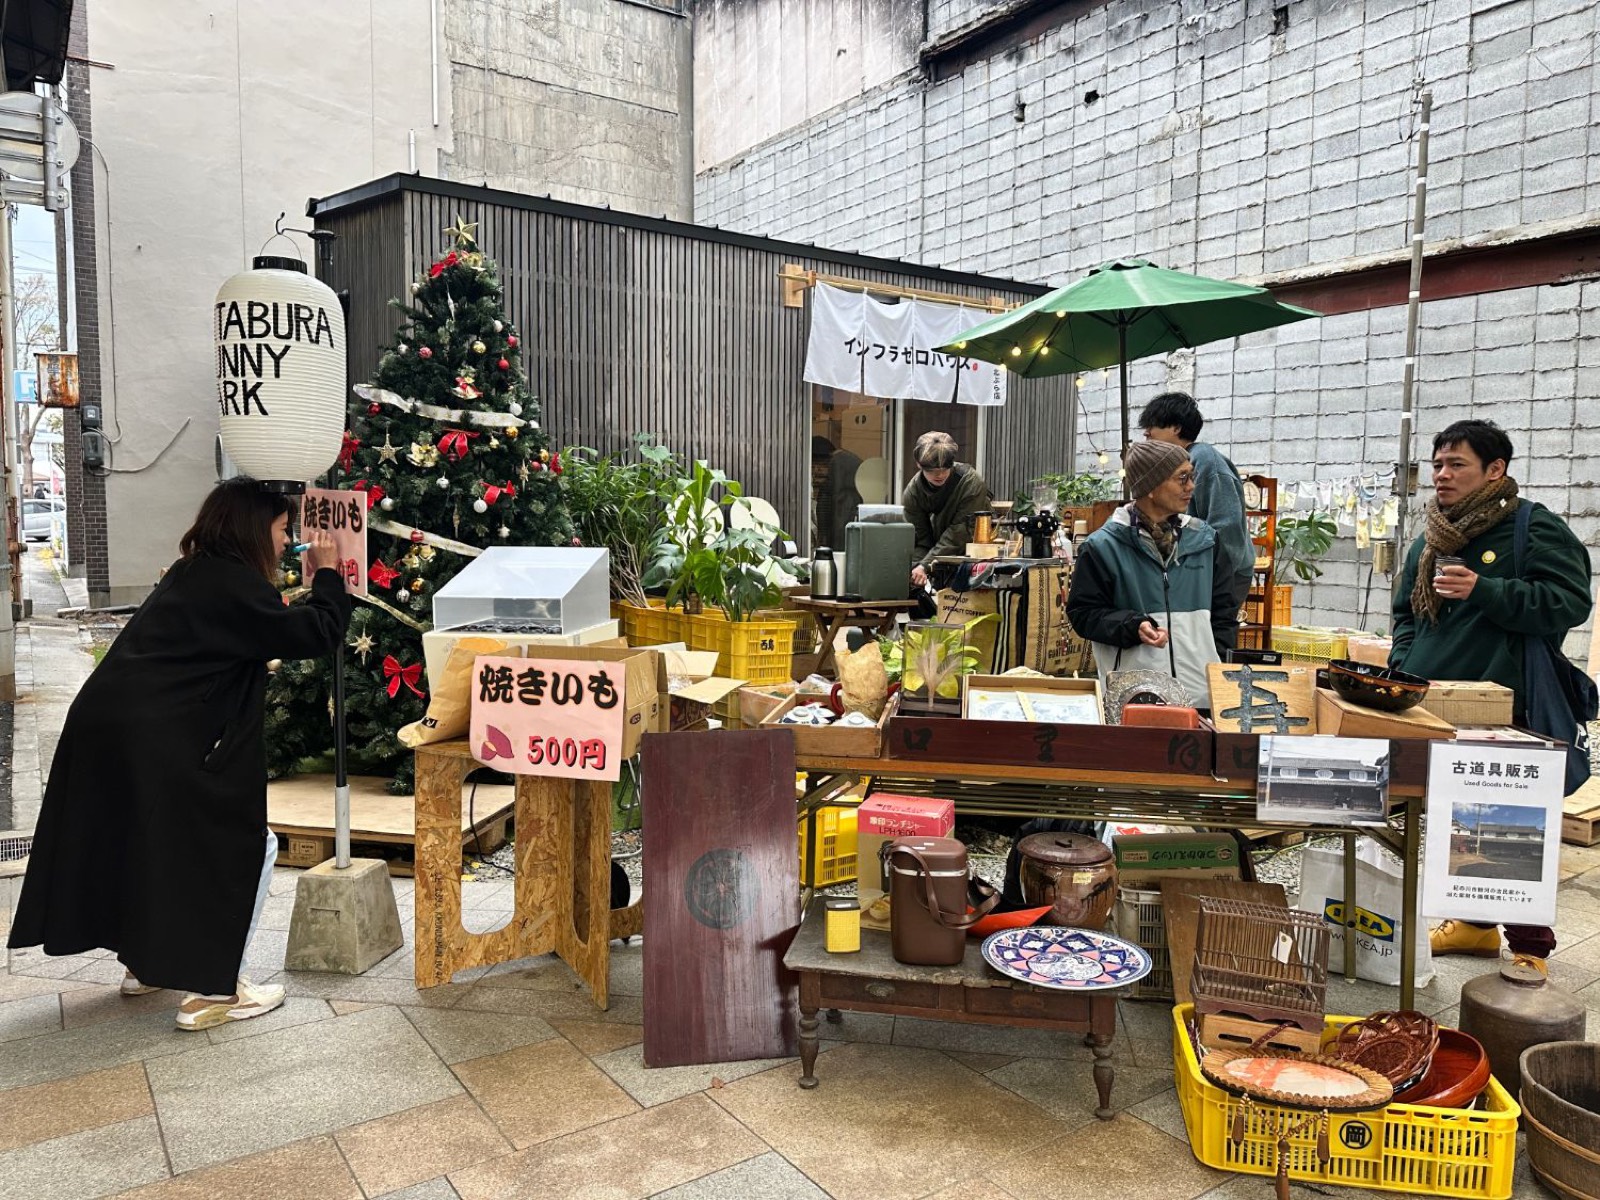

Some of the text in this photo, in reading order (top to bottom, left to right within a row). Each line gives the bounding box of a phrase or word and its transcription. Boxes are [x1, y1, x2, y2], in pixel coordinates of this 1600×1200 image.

[304, 495, 363, 533] 焼きいも
[479, 664, 619, 709] 焼きいも
[527, 735, 607, 770] 500円
[1452, 760, 1540, 779] 古道具販売
[1481, 780, 1502, 788] Goods
[1333, 907, 1383, 933] IEA
